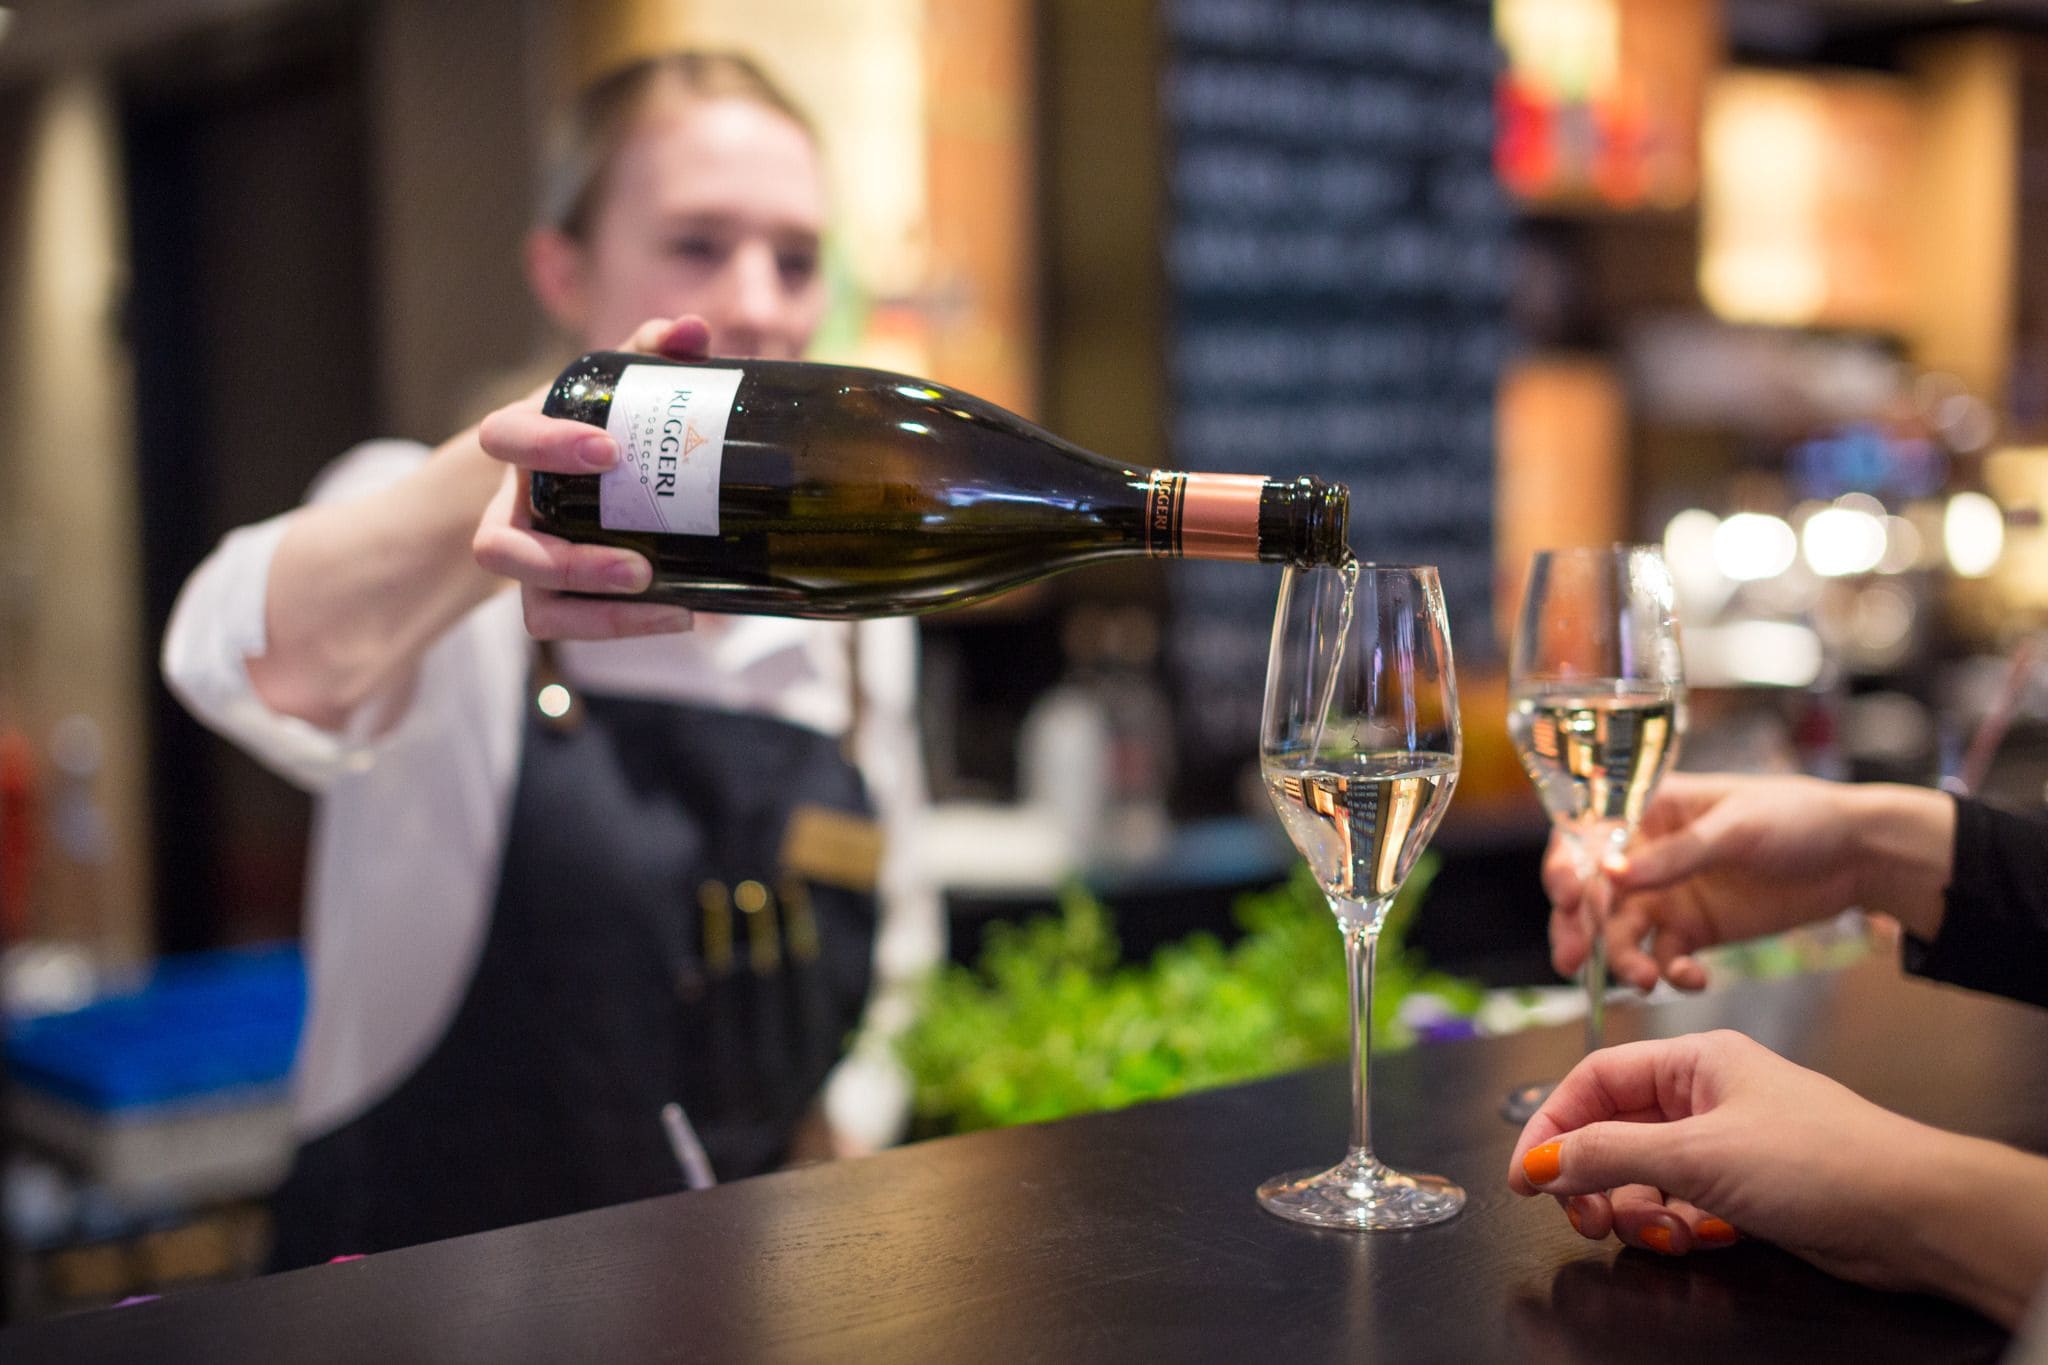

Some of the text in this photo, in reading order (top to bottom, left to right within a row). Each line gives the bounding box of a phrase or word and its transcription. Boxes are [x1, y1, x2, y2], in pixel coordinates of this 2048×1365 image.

[640, 398, 661, 485] OSECCO
[655, 391, 692, 497] RUGGERI
[1155, 473, 1173, 530] UGGERI
